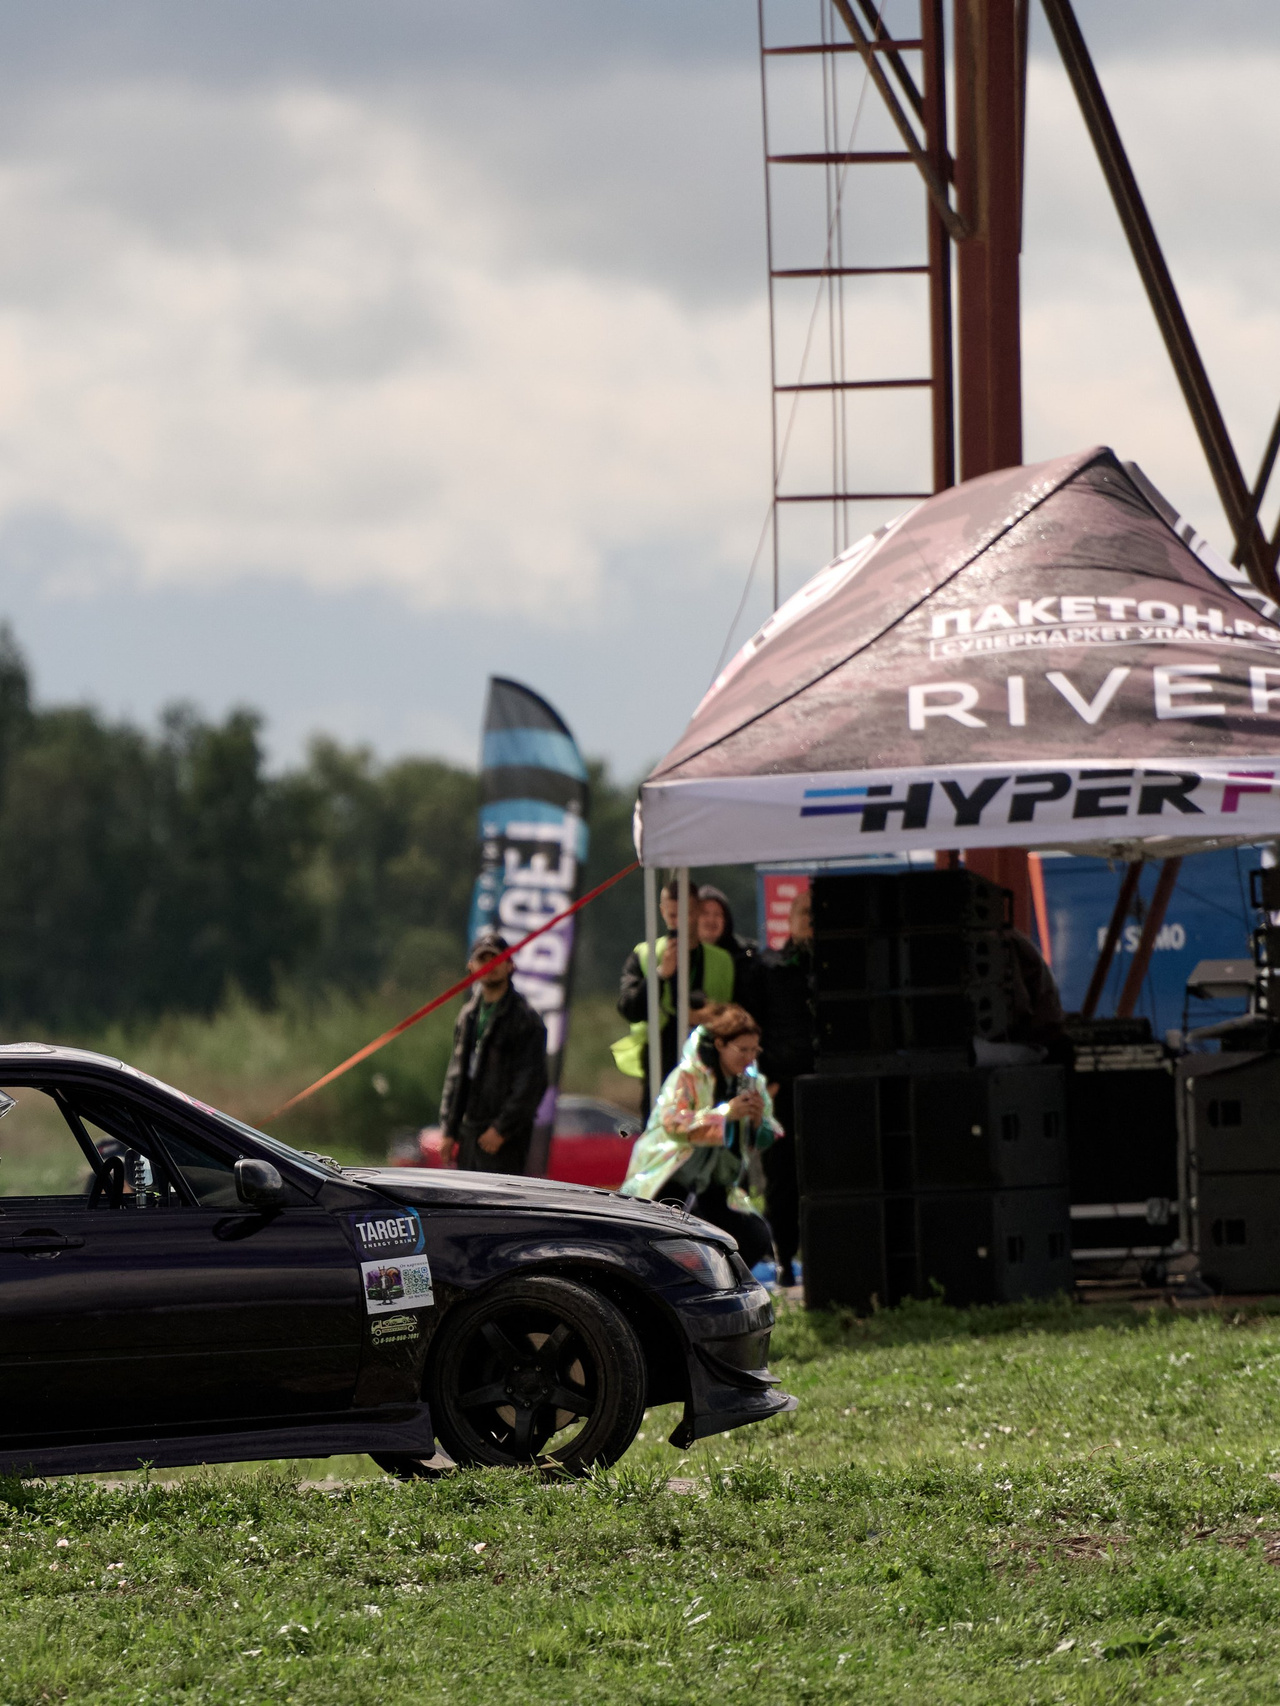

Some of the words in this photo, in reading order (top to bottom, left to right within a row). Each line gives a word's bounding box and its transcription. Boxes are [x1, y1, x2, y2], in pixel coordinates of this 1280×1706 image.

[940, 625, 1131, 656] СУПЕРМАРКЕТ
[355, 1215, 417, 1243] TARGET
[363, 1241, 391, 1249] ENERGY
[394, 1237, 417, 1245] DRINK
